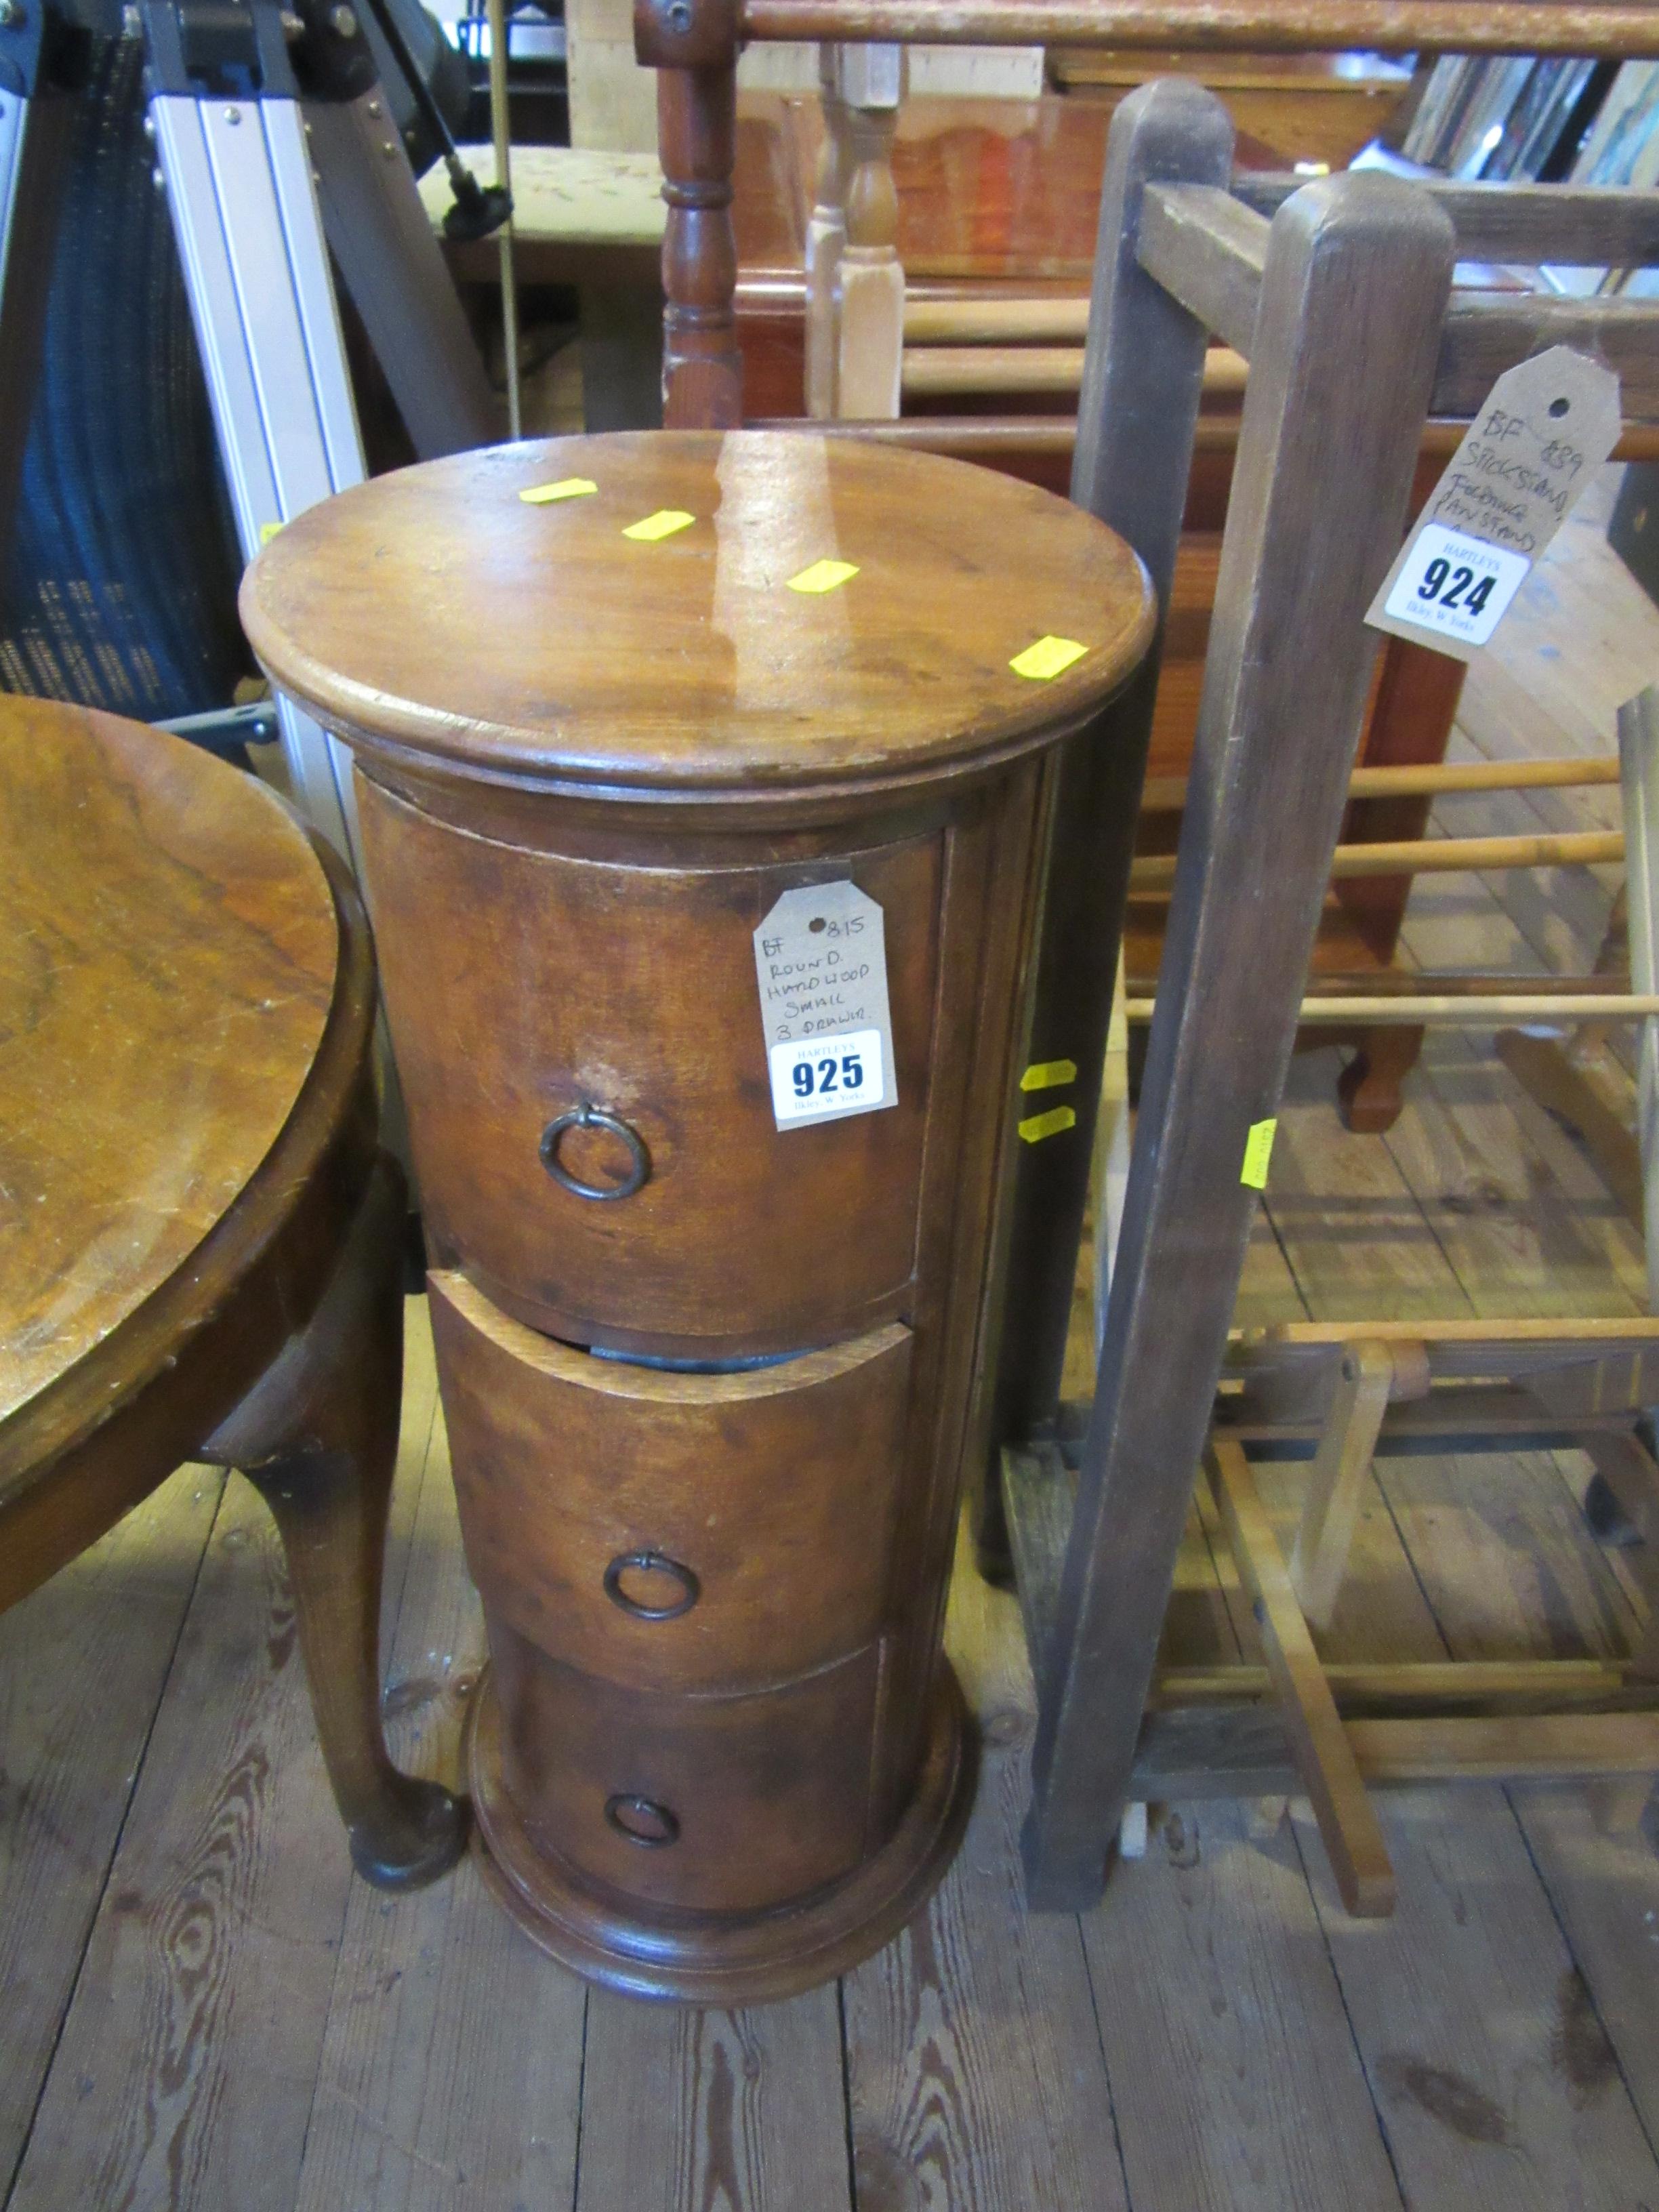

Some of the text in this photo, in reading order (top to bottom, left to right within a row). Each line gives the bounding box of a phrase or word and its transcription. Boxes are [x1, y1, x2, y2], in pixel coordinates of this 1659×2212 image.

[1483, 409, 1523, 441] BF
[1443, 542, 1501, 571] HARTLEYS
[1417, 557, 1498, 617] 924
[827, 916, 865, 938] 815
[783, 994, 845, 1019] SMALL
[776, 1025, 792, 1040] 3
[798, 1042, 856, 1059] HARTLEYS
[792, 1054, 863, 1097] 925
[840, 1092, 865, 1103] Yorks
